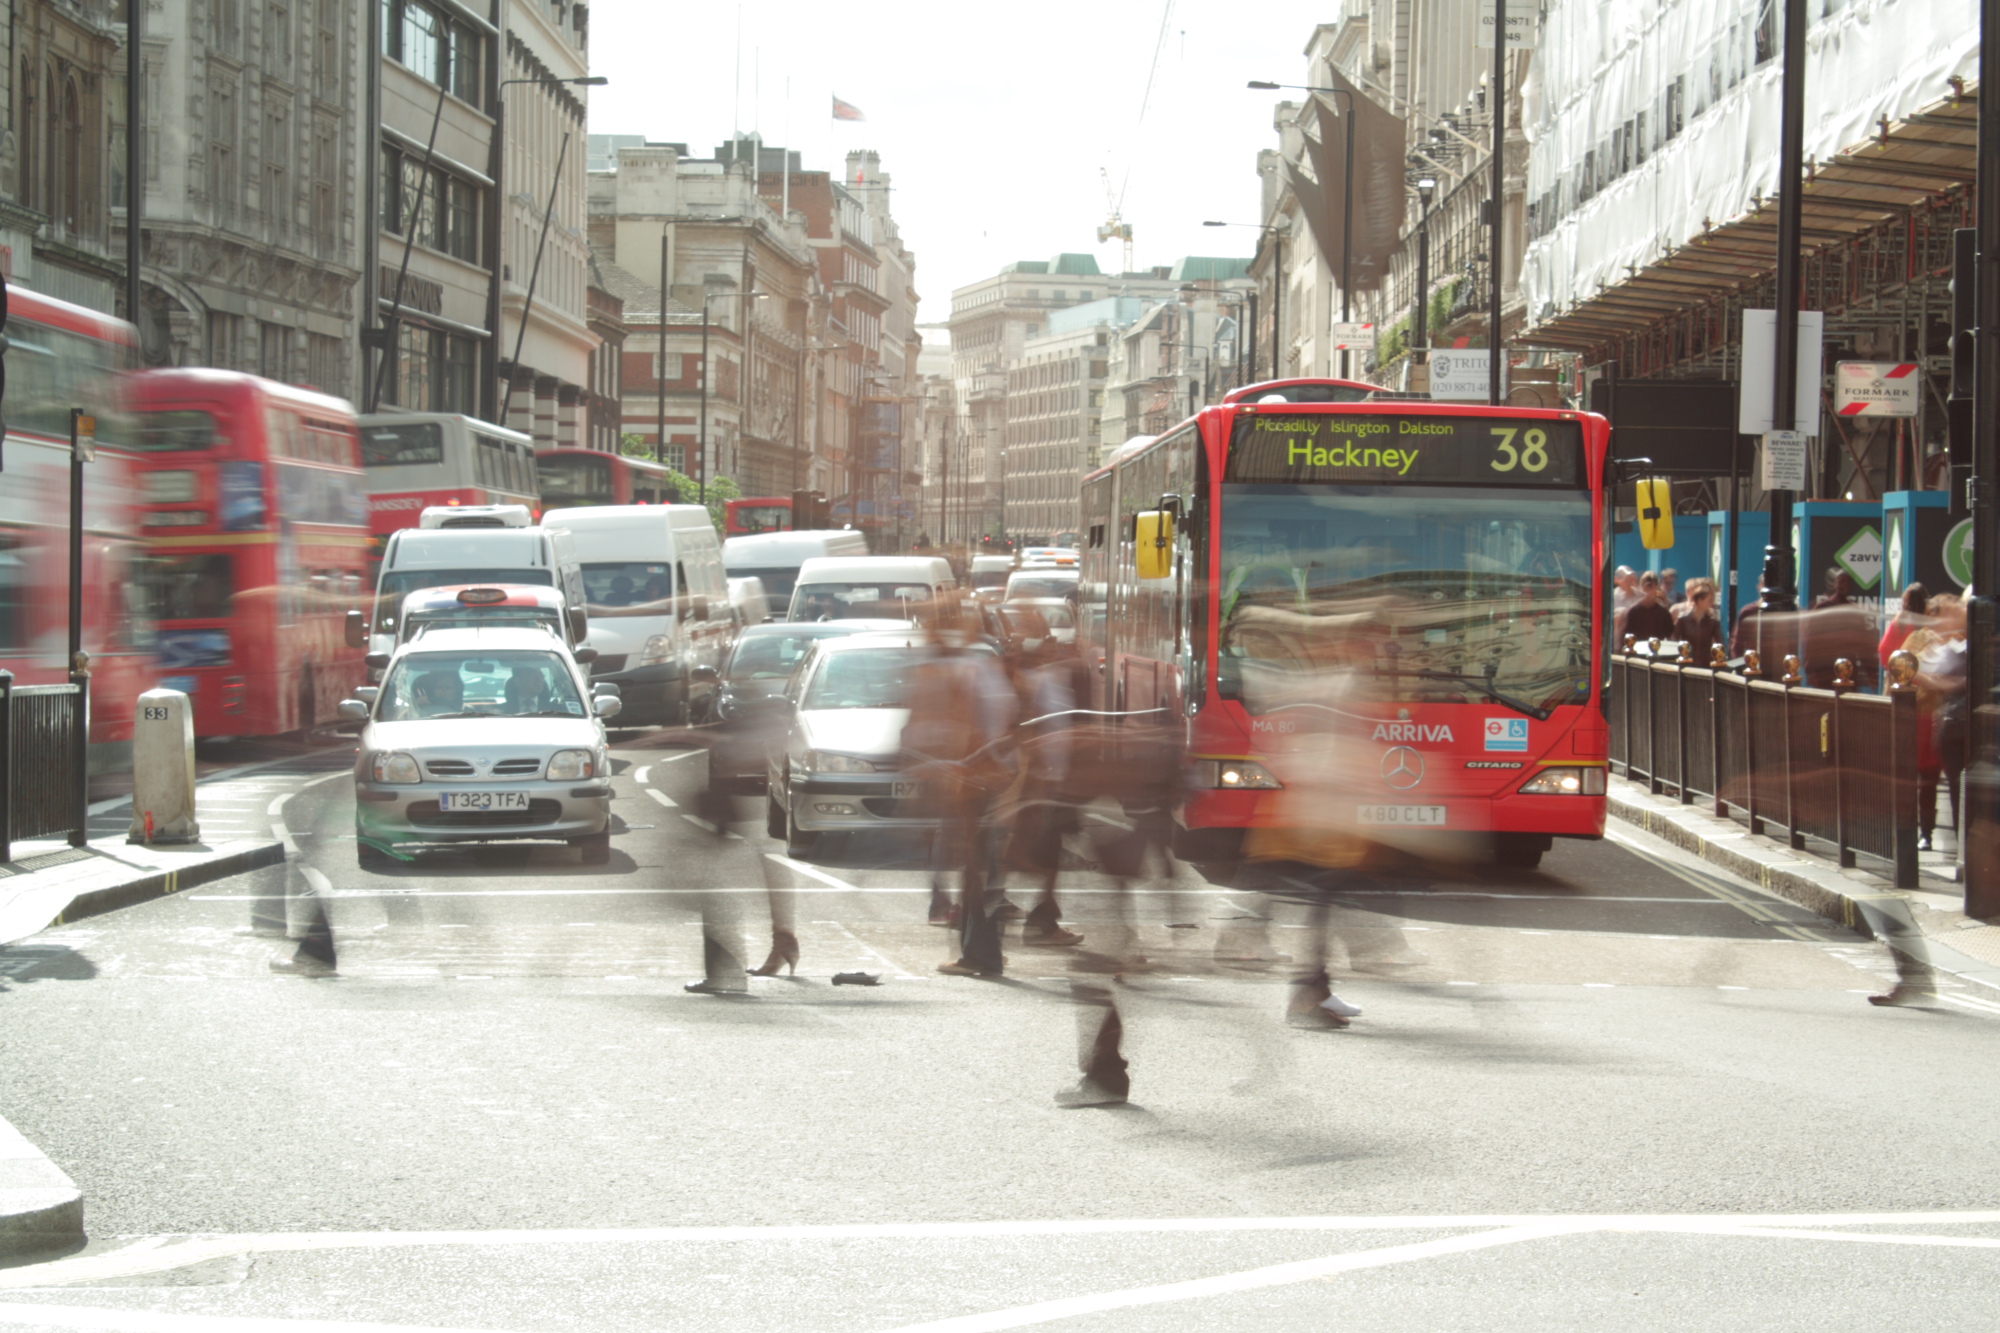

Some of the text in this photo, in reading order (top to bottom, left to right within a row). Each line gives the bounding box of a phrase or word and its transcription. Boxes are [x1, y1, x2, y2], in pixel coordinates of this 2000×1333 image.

[1483, 16, 1497, 25] 02
[1453, 358, 1500, 369] TRITO
[1432, 382, 1452, 393] 020
[1454, 382, 1475, 393] 8871
[1845, 388, 1910, 397] FORMARK
[1255, 418, 1454, 438] Piccadilly Islington Dalston
[1490, 428, 1549, 472] 38
[1288, 439, 1419, 475] Hackney
[146, 707, 166, 719] 33
[1252, 720, 1296, 733] MA 80
[1372, 724, 1455, 742] ARRIVA
[449, 793, 492, 807] T323
[495, 793, 527, 807] TFA
[1363, 807, 1439, 822] 480 CLT
